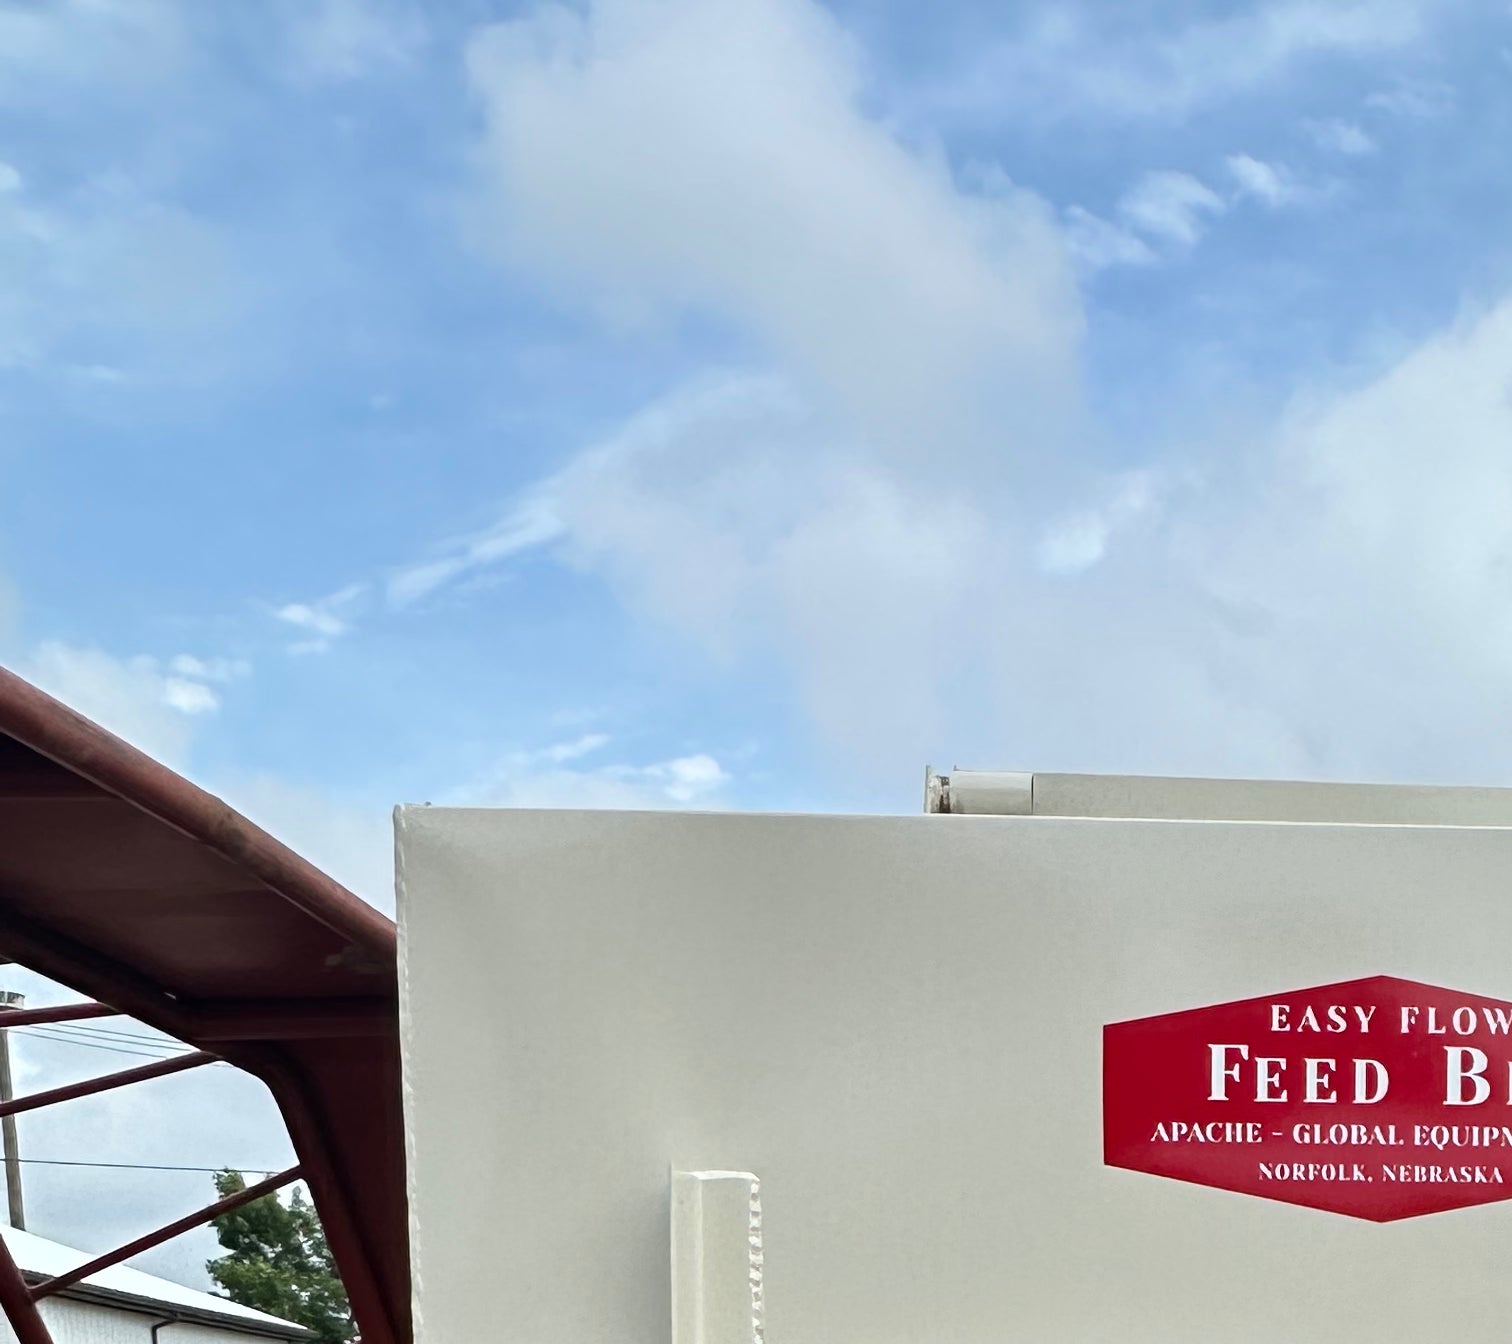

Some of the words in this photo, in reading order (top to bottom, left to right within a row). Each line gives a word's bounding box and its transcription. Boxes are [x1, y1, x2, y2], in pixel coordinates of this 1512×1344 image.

[1270, 1004, 1377, 1034] EASY
[1150, 1121, 1263, 1144] APACHE
[1292, 1123, 1405, 1146] GLOBAL
[1382, 1164, 1504, 1184] NEBRASKA
